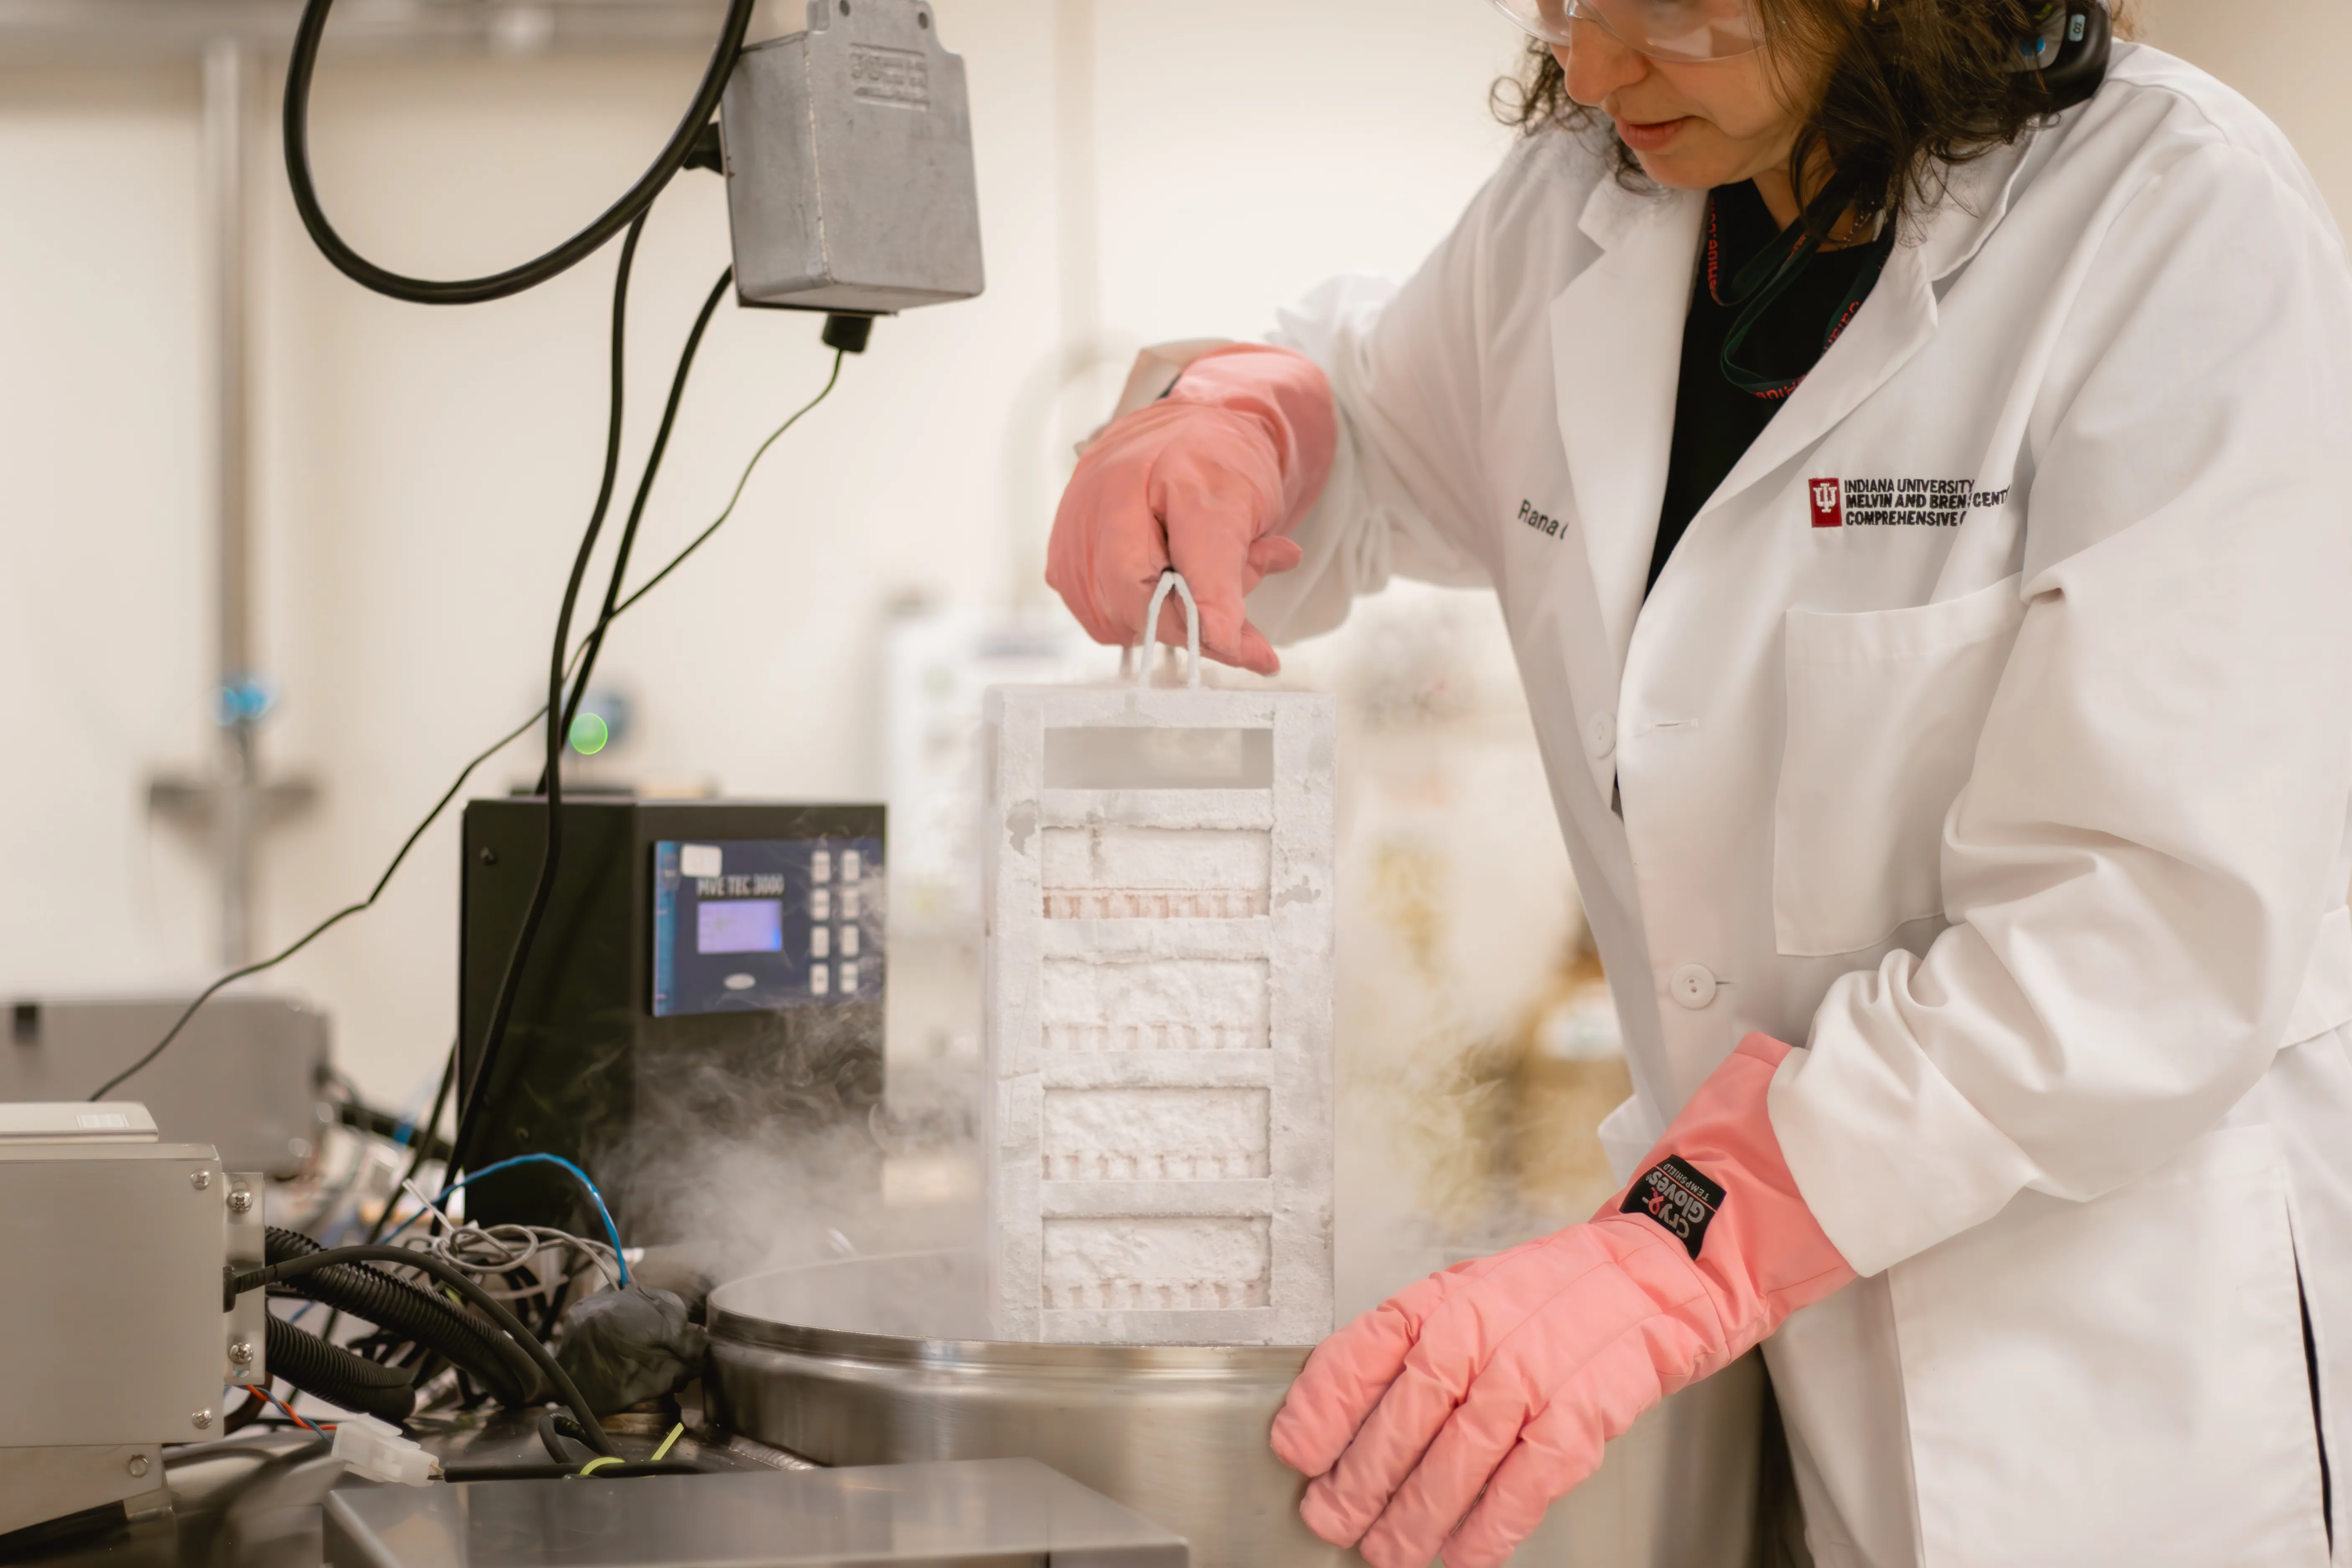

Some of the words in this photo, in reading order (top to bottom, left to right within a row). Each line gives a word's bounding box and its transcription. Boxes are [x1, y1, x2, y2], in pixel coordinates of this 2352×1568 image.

[1844, 478, 1894, 493] INDIANA
[1897, 479, 1975, 494] UNIVERSITY
[1846, 493, 1893, 509] MELVIN
[1895, 494, 1927, 508] AND
[1518, 499, 1559, 537] Rana
[1846, 511, 1958, 527] COMPREHENSIVE
[1663, 1163, 1710, 1201] TEMPSHIELD
